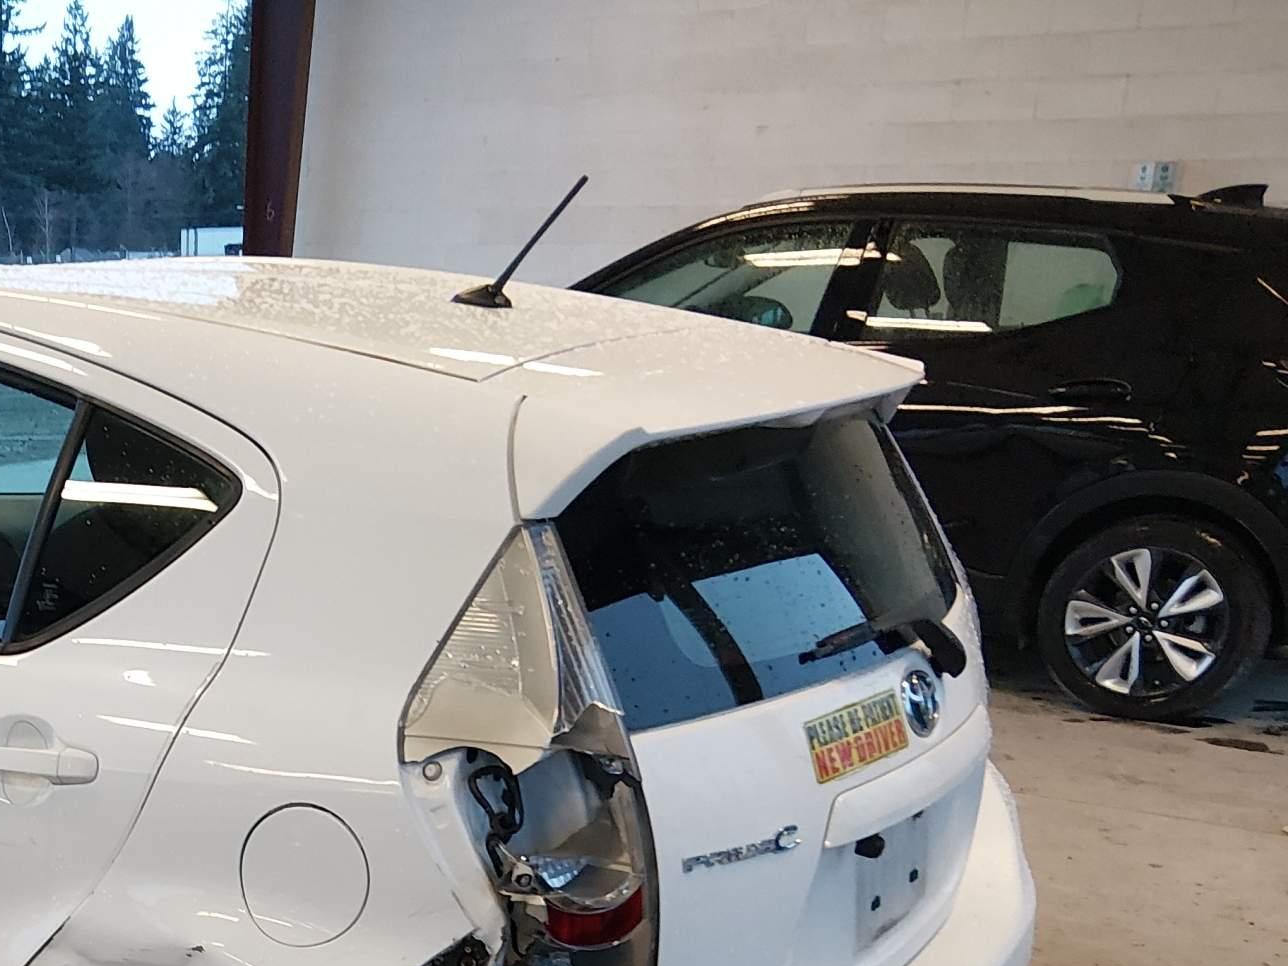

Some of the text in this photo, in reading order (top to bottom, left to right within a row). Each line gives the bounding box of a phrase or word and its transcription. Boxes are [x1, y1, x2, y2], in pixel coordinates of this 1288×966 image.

[807, 693, 901, 750] PLEASE BE PATIENT
[815, 719, 907, 779] NEW DRIVER
